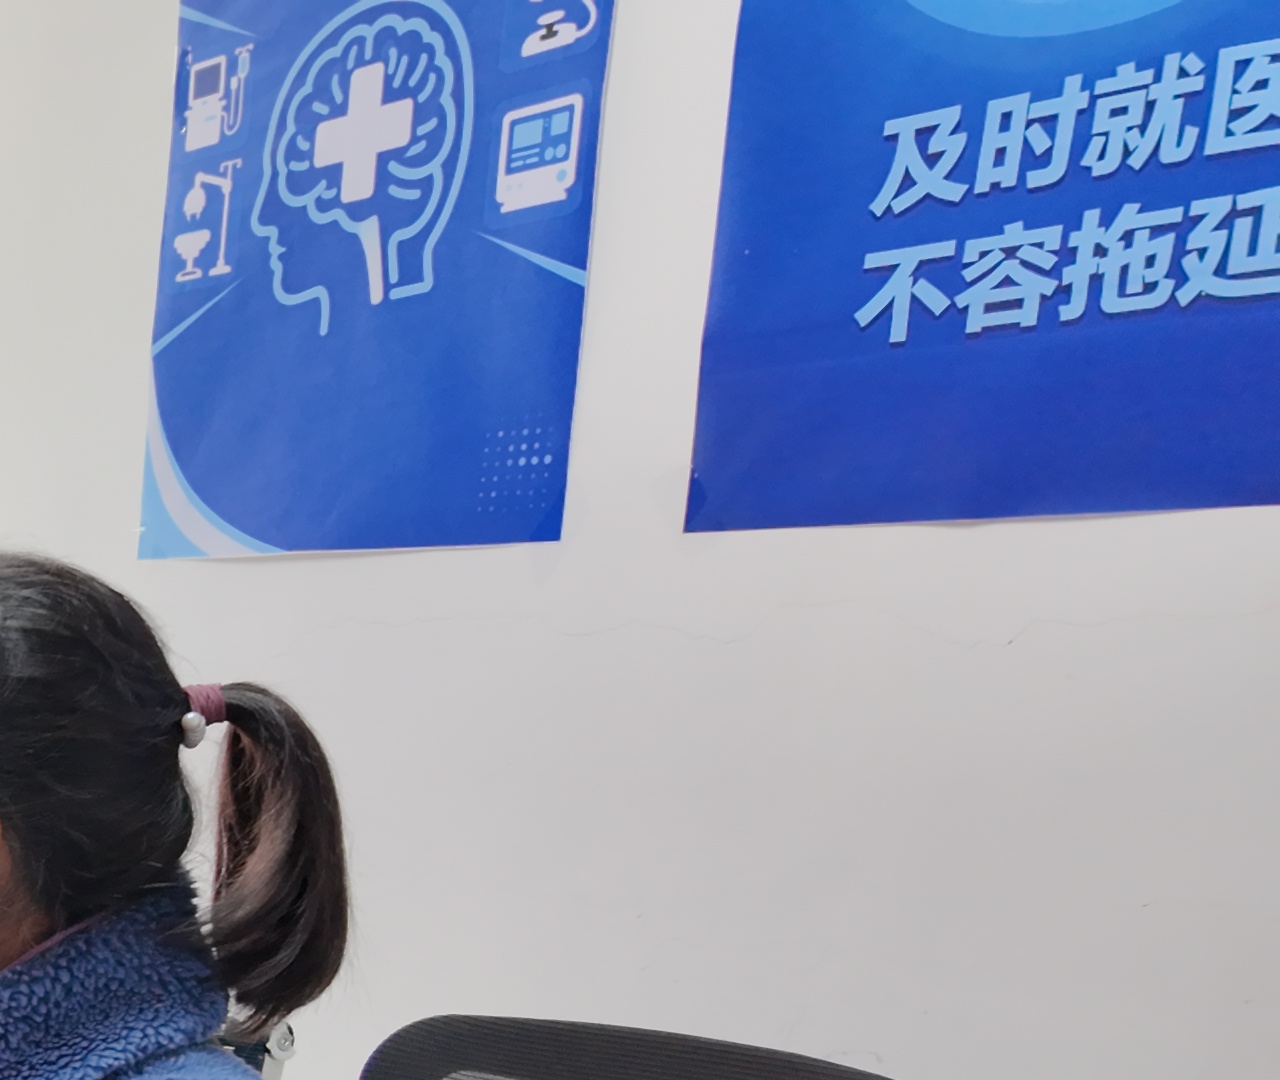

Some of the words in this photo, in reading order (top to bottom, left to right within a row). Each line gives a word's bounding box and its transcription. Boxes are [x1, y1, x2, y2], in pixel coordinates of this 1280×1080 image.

[868, 37, 1280, 218] 及时就医
[853, 185, 1280, 345] 不容拖延
